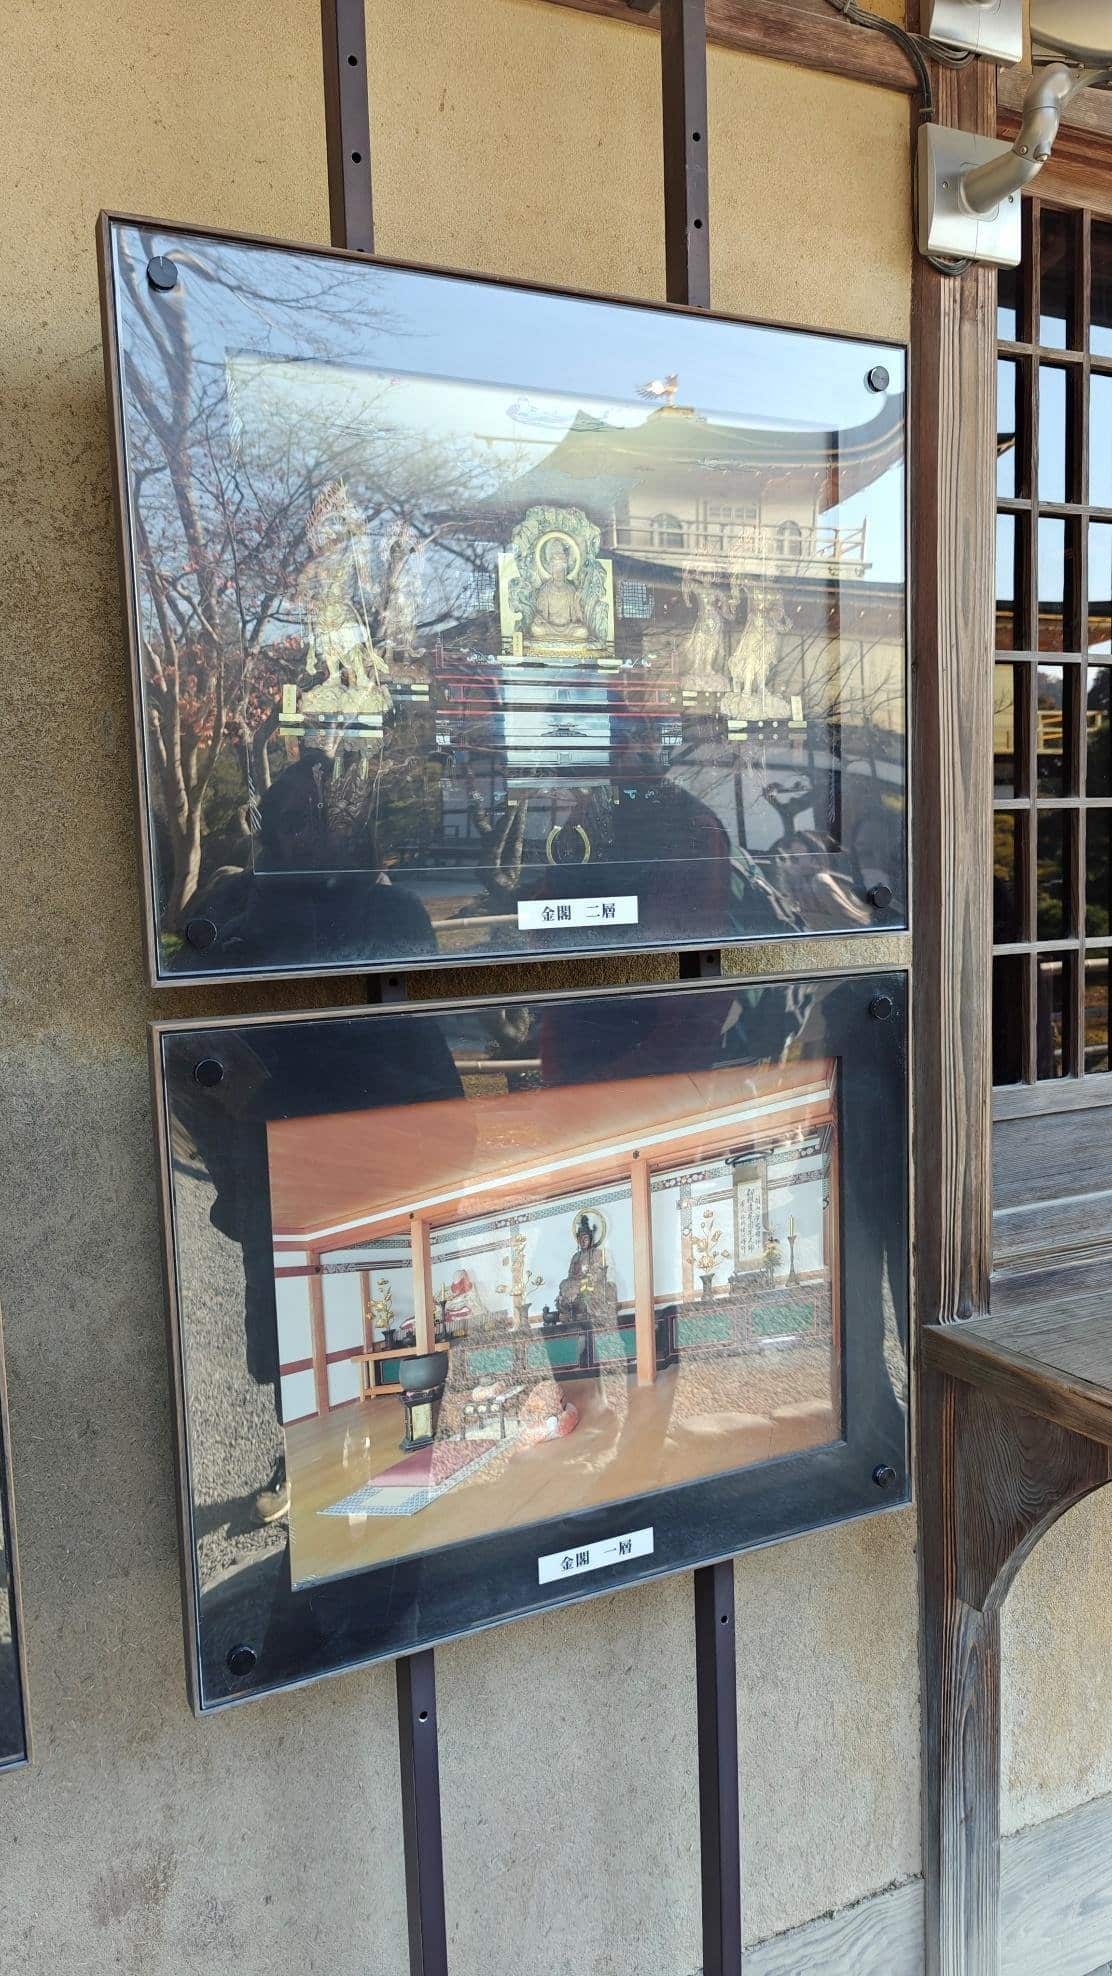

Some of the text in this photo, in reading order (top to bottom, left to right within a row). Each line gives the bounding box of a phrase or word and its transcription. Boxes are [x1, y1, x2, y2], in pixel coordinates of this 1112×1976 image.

[542, 903, 615, 921] 金閣 二層
[561, 1539, 632, 1571] 金閣 一層
